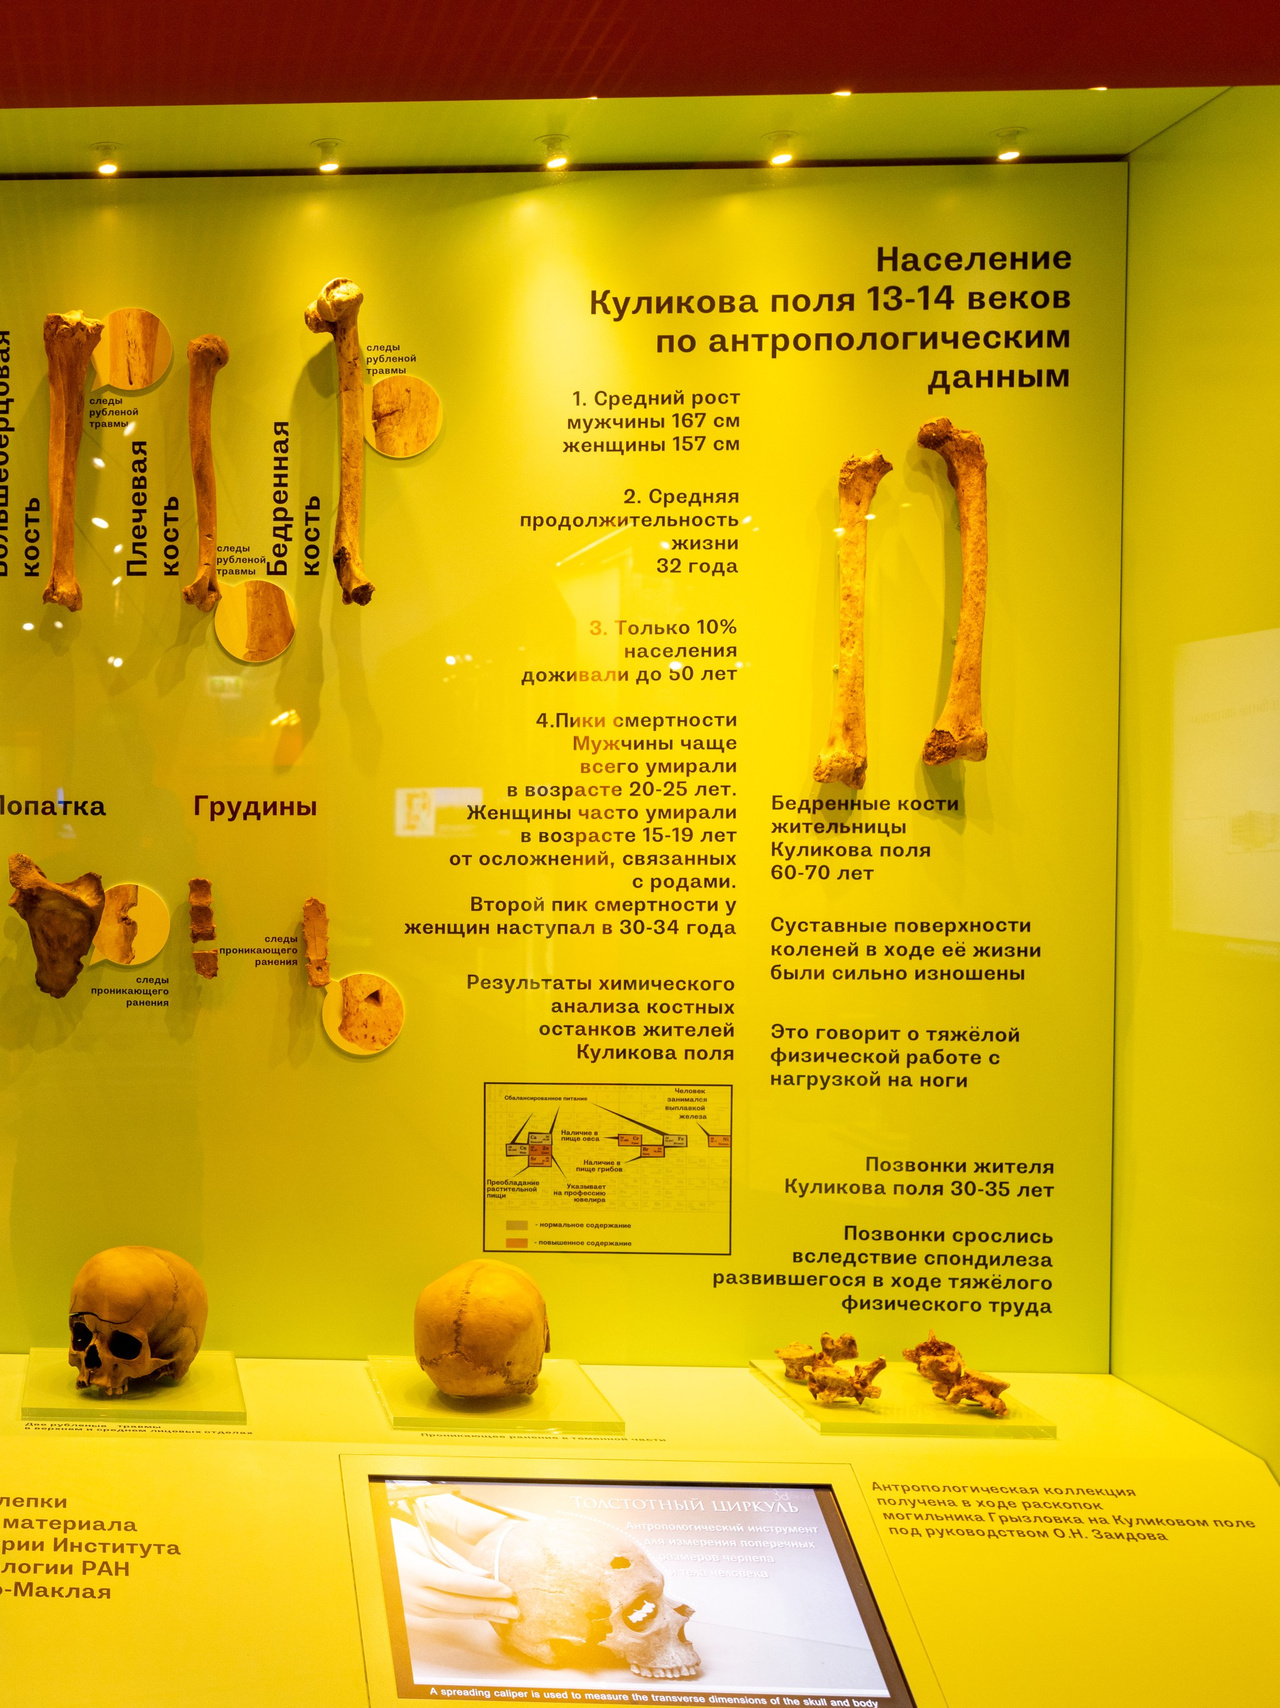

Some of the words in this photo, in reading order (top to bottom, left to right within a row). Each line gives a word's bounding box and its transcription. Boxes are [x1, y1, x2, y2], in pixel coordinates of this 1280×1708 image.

[878, 247, 1071, 272] Население
[591, 290, 758, 322] Куликова
[772, 294, 854, 312] поля
[868, 285, 954, 311] 13-14
[969, 291, 1070, 309] веков
[367, 344, 400, 352] следы
[657, 335, 696, 353] по
[709, 330, 1069, 358] антропологическим
[367, 354, 416, 365] рубленой
[366, 367, 406, 376] травмы
[928, 369, 1069, 395] данным
[90, 398, 122, 406] следы
[573, 391, 586, 406] 1.
[595, 391, 684, 410] Средний
[692, 393, 740, 409] рост
[90, 407, 138, 418] рубленой
[89, 421, 129, 430] травмы
[563, 441, 665, 455] женщины
[673, 436, 706, 451] 157
[714, 440, 739, 451] см
[267, 422, 294, 575] Бедренная
[127, 441, 147, 576] Плечевая
[521, 516, 738, 531] продолжительность
[25, 498, 40, 576] кость
[164, 497, 179, 576] кость
[304, 496, 320, 575] кость
[217, 545, 250, 553] следы
[217, 554, 265, 565] рубленой
[657, 558, 681, 573] 32
[689, 562, 738, 576] года
[216, 568, 255, 577] травмы
[625, 646, 736, 658] населения
[195, 795, 316, 821] Грудины
[772, 795, 890, 814] Бедренные
[898, 800, 958, 810] кости
[467, 805, 570, 823] Женщины
[579, 809, 638, 819] часто
[646, 808, 736, 823] умирали
[771, 823, 906, 837] жительницы
[771, 917, 886, 936] Суставные
[895, 921, 1030, 936] поверхности
[265, 936, 297, 944] следы
[220, 947, 297, 956] проникающего
[255, 959, 297, 967] ранения
[136, 977, 169, 985] следы
[468, 974, 591, 993] Результаты
[599, 979, 734, 991] химического
[91, 987, 169, 996] проникающего
[127, 999, 168, 1008] ранения
[487, 1178, 539, 1186] Преобладание
[845, 1225, 944, 1242] Позвонки
[953, 1231, 1053, 1246] срослись
[793, 1252, 916, 1267] вследствие
[924, 1254, 1053, 1269] спондилеза
[873, 1481, 1039, 1494] Антропологическая
[1044, 1487, 1136, 1498] коллекция
[625, 1521, 744, 1533] Антропологический
[747, 1524, 819, 1535] инструмент
[889, 1527, 921, 1539] под
[925, 1529, 1050, 1540] руководством
[1052, 1527, 1089, 1539] О.Н.
[1091, 1528, 1169, 1543] Заидова
[430, 1687, 438, 1695] A
[441, 1688, 490, 1698] spreading
[494, 1689, 528, 1699] caliper
[531, 1690, 540, 1698] is
[544, 1690, 568, 1699] used
[571, 1692, 581, 1700] to
[585, 1693, 629, 1701] measure
[632, 1693, 648, 1701] the
[651, 1694, 705, 1703] transverse
[708, 1695, 767, 1704] dimensions
[770, 1696, 780, 1704] of
[783, 1697, 800, 1705] the
[803, 1698, 827, 1706] skull
[830, 1698, 850, 1707] and
[853, 1699, 878, 1708] body
